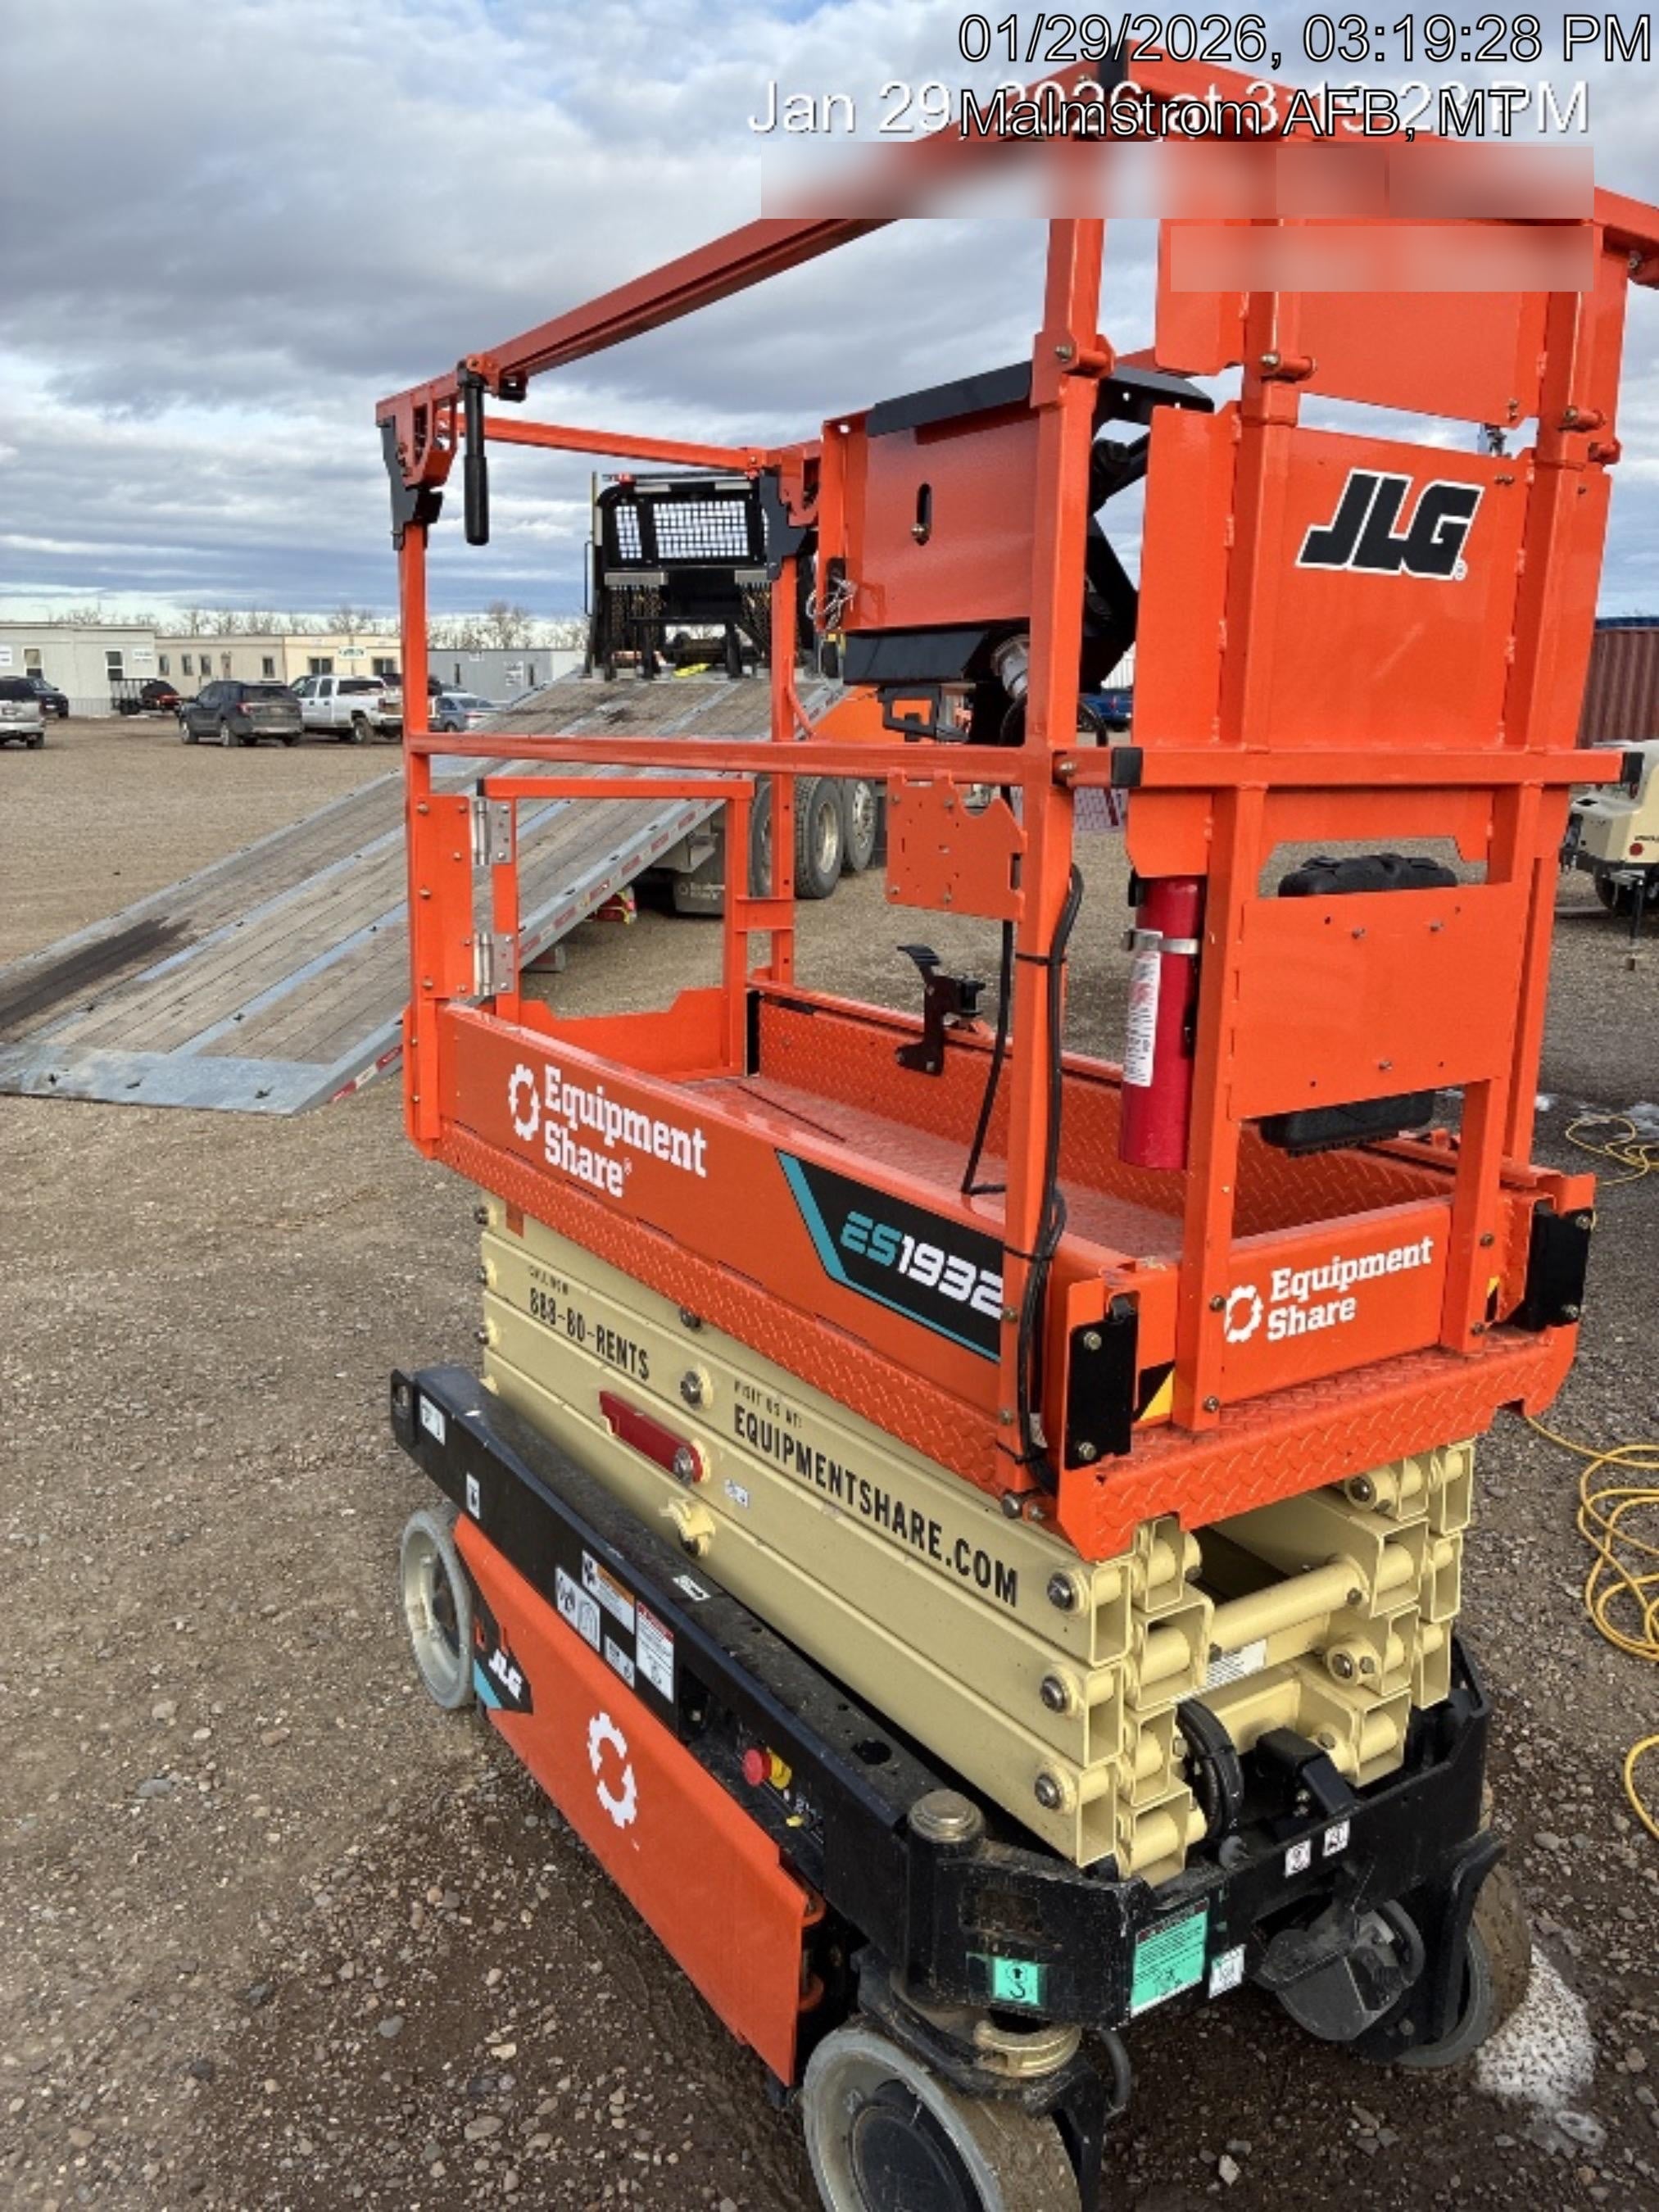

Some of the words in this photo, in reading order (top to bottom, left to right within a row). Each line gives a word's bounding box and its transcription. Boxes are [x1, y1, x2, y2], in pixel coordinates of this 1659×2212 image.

[1295, 468, 1484, 581] JLG
[544, 1064, 708, 1178] Equipment
[544, 1119, 623, 1199] Share
[841, 1211, 1004, 1321] ES1932
[1267, 1296, 1357, 1341] Share
[1270, 1235, 1434, 1303] Equipment
[733, 1402, 1018, 1608] EQUIPMENTSHARE.COM
